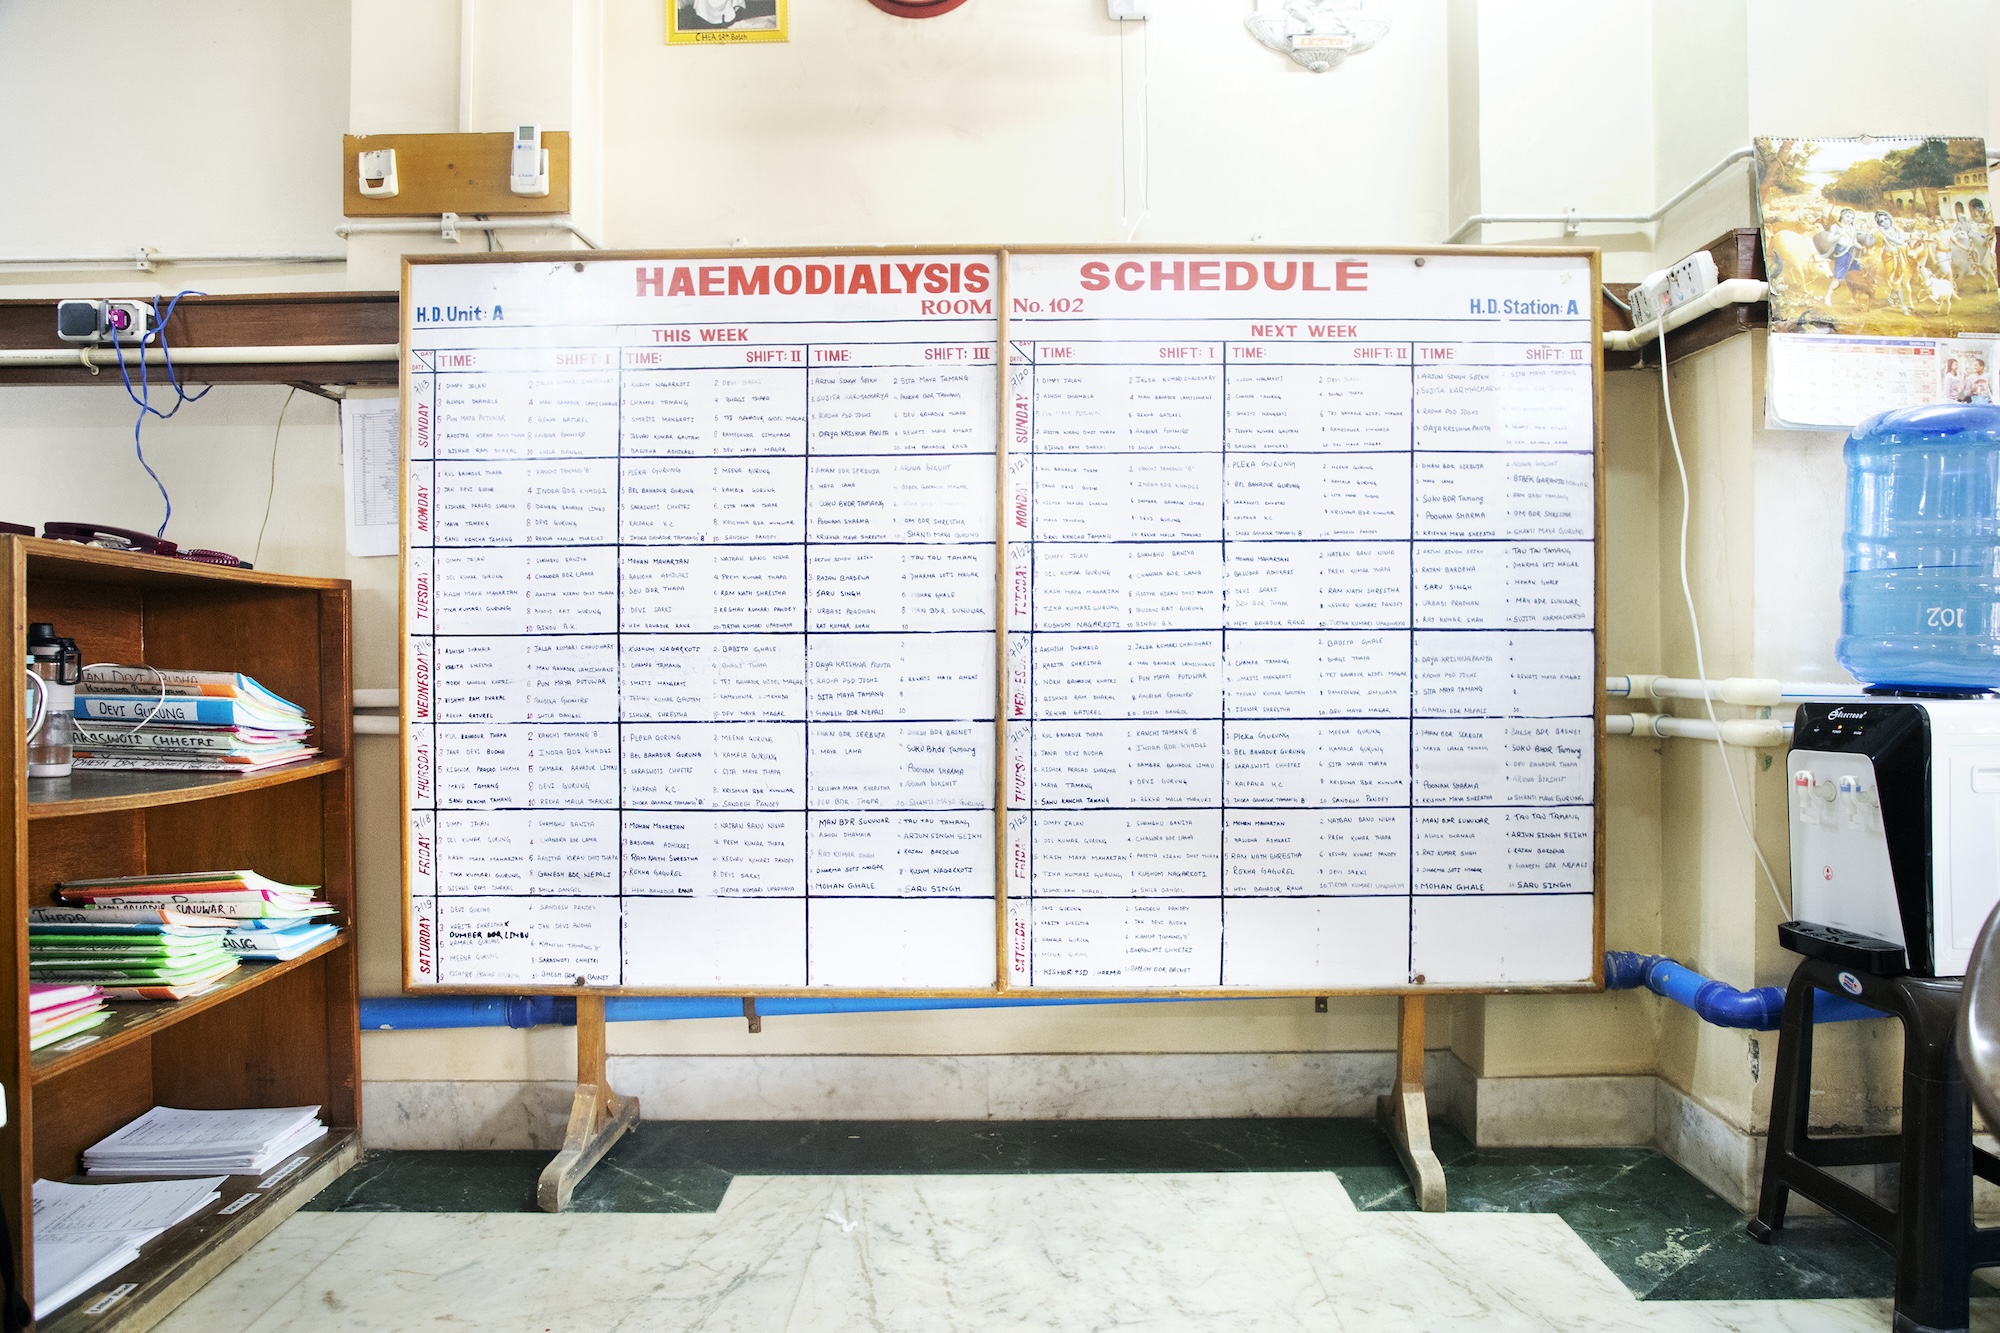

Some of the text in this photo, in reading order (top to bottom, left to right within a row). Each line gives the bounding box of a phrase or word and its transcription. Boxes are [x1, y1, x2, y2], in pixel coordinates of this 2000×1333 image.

[636, 262, 990, 297] HAEMODIALYSIS
[1080, 260, 1369, 292] SCHEDULE
[492, 304, 504, 320] A
[921, 298, 992, 316] ROOM
[1013, 298, 1084, 313] No. 102
[1566, 299, 1579, 314] A
[652, 328, 749, 343] THIS WEEK
[1251, 325, 1358, 337] NEXT WEEK
[438, 354, 476, 366] TIME:
[556, 353, 602, 365] SHIFT:
[626, 352, 663, 364] TIME:
[746, 350, 801, 362] SHIFT: II
[814, 350, 852, 362] TIME:
[925, 347, 990, 360] SHIFT: III
[1041, 347, 1075, 358] TIME:
[1159, 347, 1214, 358] SHIFT: I
[1233, 348, 1266, 358] TIME:
[1353, 348, 1407, 358] SHIFT: II
[1420, 348, 1456, 359] TIME:
[1526, 349, 1583, 360] SHIFT: III
[1011, 369, 1029, 387] 7/20
[418, 403, 429, 448] SUNDAY
[1016, 394, 1028, 443] SUNDAY
[418, 485, 428, 532] MONDAY
[1926, 607, 1964, 628] 102
[1010, 636, 1029, 657] 7/23
[417, 652, 429, 718] WEDNESDAY
[100, 703, 185, 720] DEVI GURUNG
[153, 734, 214, 747] CHHETRI
[1011, 726, 1030, 743] 7/24
[413, 814, 432, 829] 7/18
[1009, 815, 1028, 831] 7/25
[419, 833, 430, 876] FRIDAY
[176, 904, 226, 915] SUNUWAR
[420, 916, 430, 974] SATURDAY
